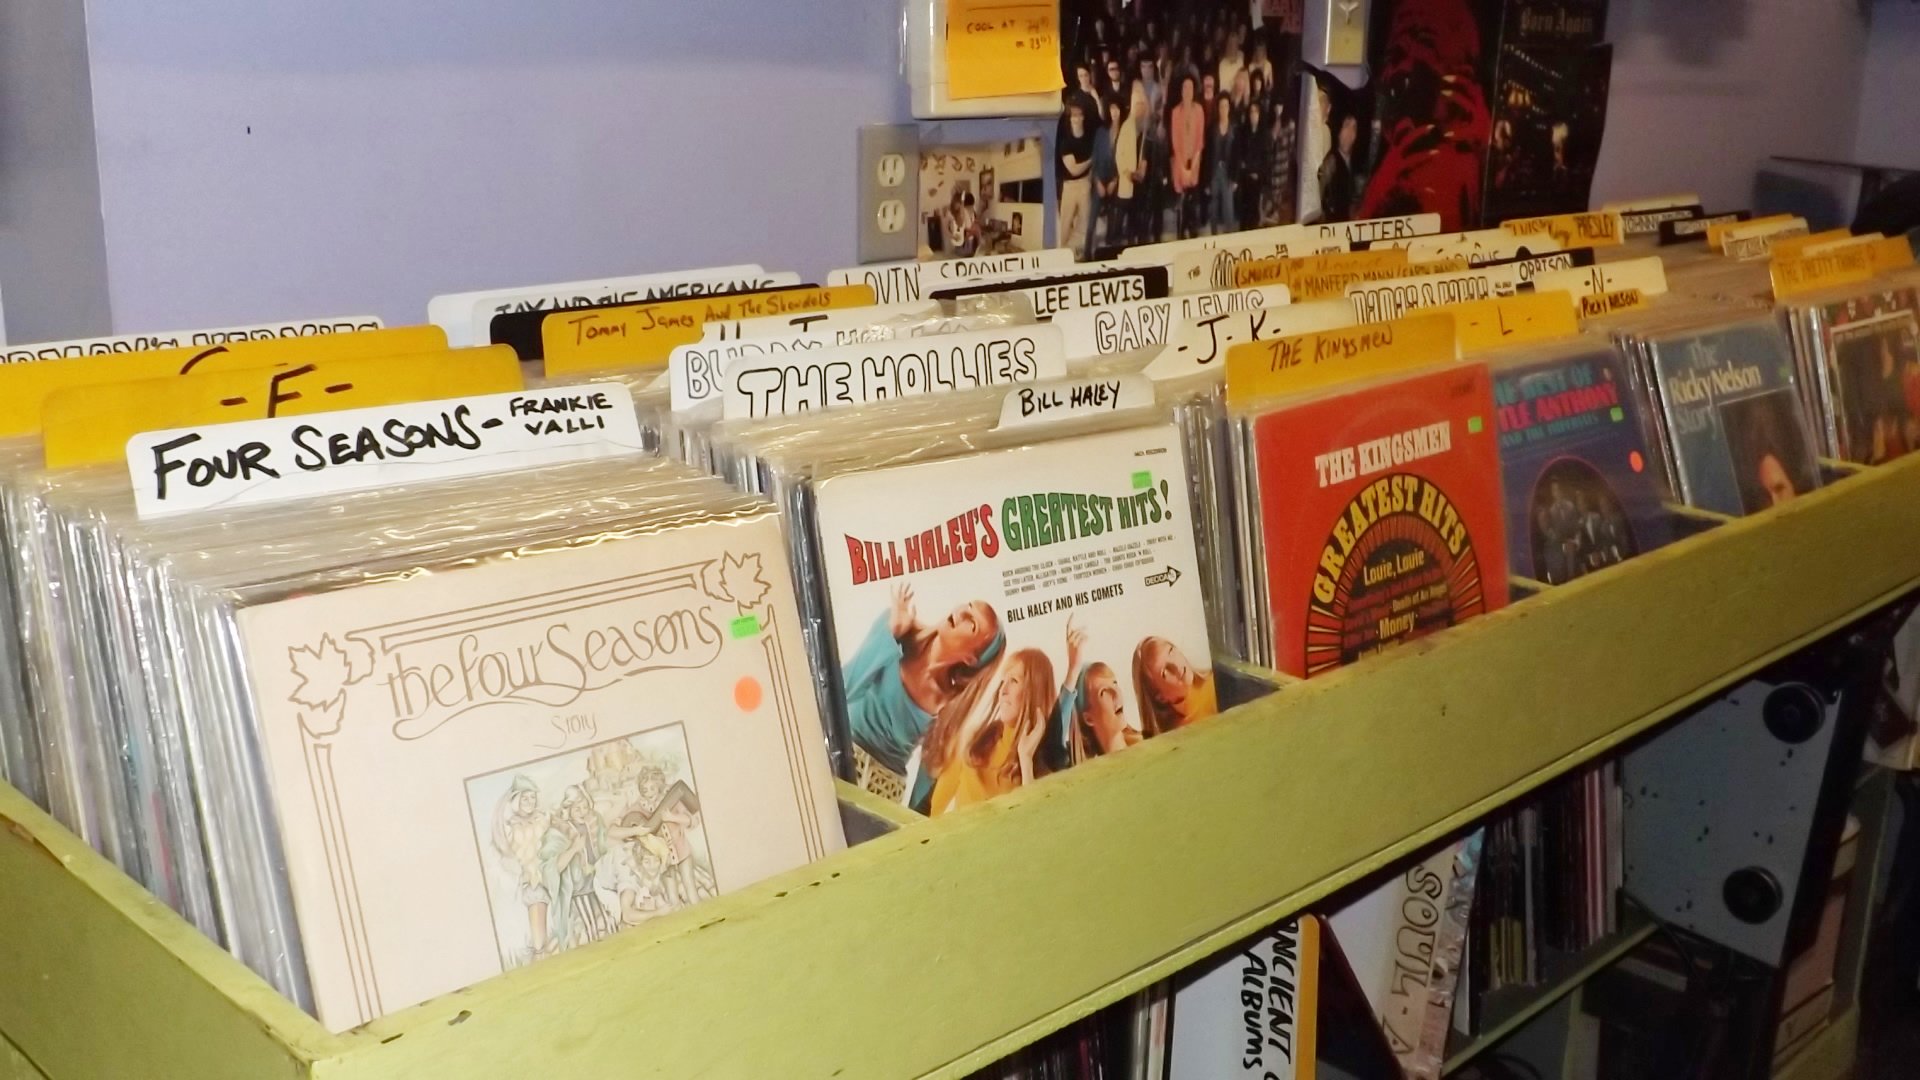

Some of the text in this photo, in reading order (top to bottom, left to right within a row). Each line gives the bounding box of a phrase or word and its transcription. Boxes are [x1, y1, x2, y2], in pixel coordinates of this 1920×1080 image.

[966, 22, 995, 34] COOL
[1034, 279, 1144, 316] LEE LEWIS
[568, 315, 627, 346] Tommy
[636, 306, 695, 331] James
[1095, 302, 1171, 356] GARY
[1269, 338, 1303, 372] THE
[737, 361, 854, 418] THE
[861, 337, 1038, 402] HOLLIES
[1070, 381, 1121, 410] HALEY
[1669, 360, 1763, 407] Ricky Nelson
[508, 392, 614, 418] FRANKIE
[524, 414, 606, 436] VALLI
[1315, 420, 1451, 487] THE KINGSMEN
[844, 479, 1172, 585] BILL HALEY'S GREATEST HITS!
[1314, 475, 1468, 604] GREATEST HITS
[1363, 549, 1426, 586] Louie, Louie
[1006, 583, 1125, 624] BILL HALEY AND HIS COMETS
[1379, 610, 1416, 640] Money
[1390, 865, 1443, 998] SOUL
[1240, 950, 1268, 1070] ALBUMS
